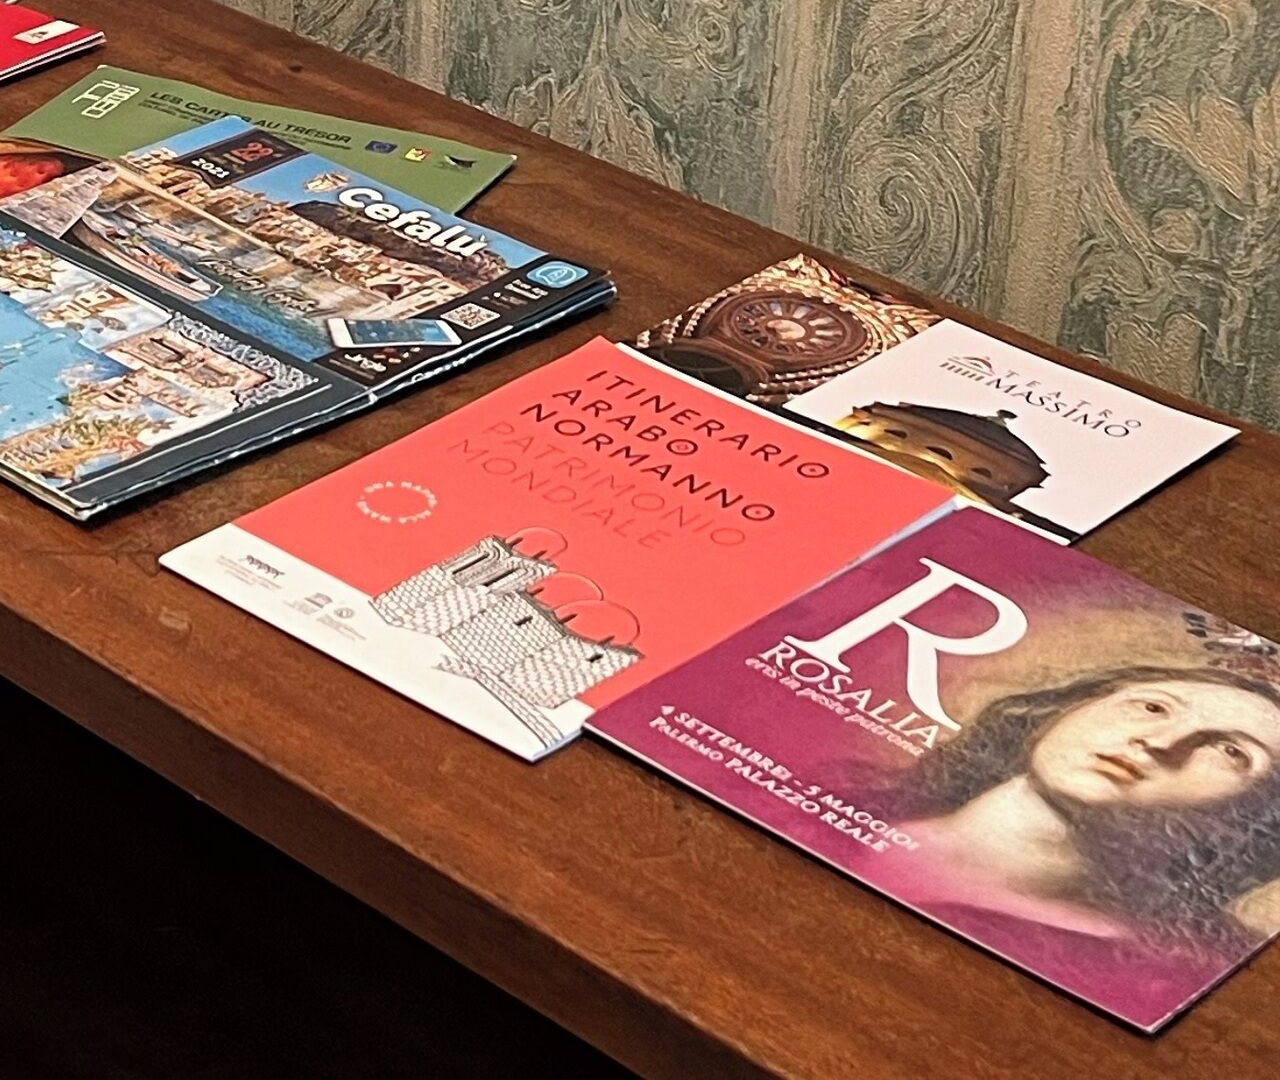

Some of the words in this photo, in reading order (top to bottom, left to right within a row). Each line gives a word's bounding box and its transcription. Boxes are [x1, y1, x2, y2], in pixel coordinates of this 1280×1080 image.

[150, 91, 184, 106] LES
[185, 101, 252, 123] CARTS
[252, 119, 281, 133] AU
[191, 157, 231, 179] 2021
[338, 188, 485, 257] Cefalù
[552, 389, 698, 455] ARABO
[586, 370, 830, 478] ITINERARIO
[986, 377, 1130, 438] MASSIMO
[1006, 370, 1142, 428] TEATRO
[447, 439, 673, 548] MONDIALE
[481, 421, 746, 546] PATRIMONIO
[520, 403, 776, 521] NORMANNO
[784, 557, 1029, 732] R
[758, 640, 939, 749] ROSALIA
[724, 757, 821, 813] PALAZZO
[820, 810, 890, 852] REALE
[802, 785, 822, 796] 5
[820, 794, 912, 846] MAGGIO
